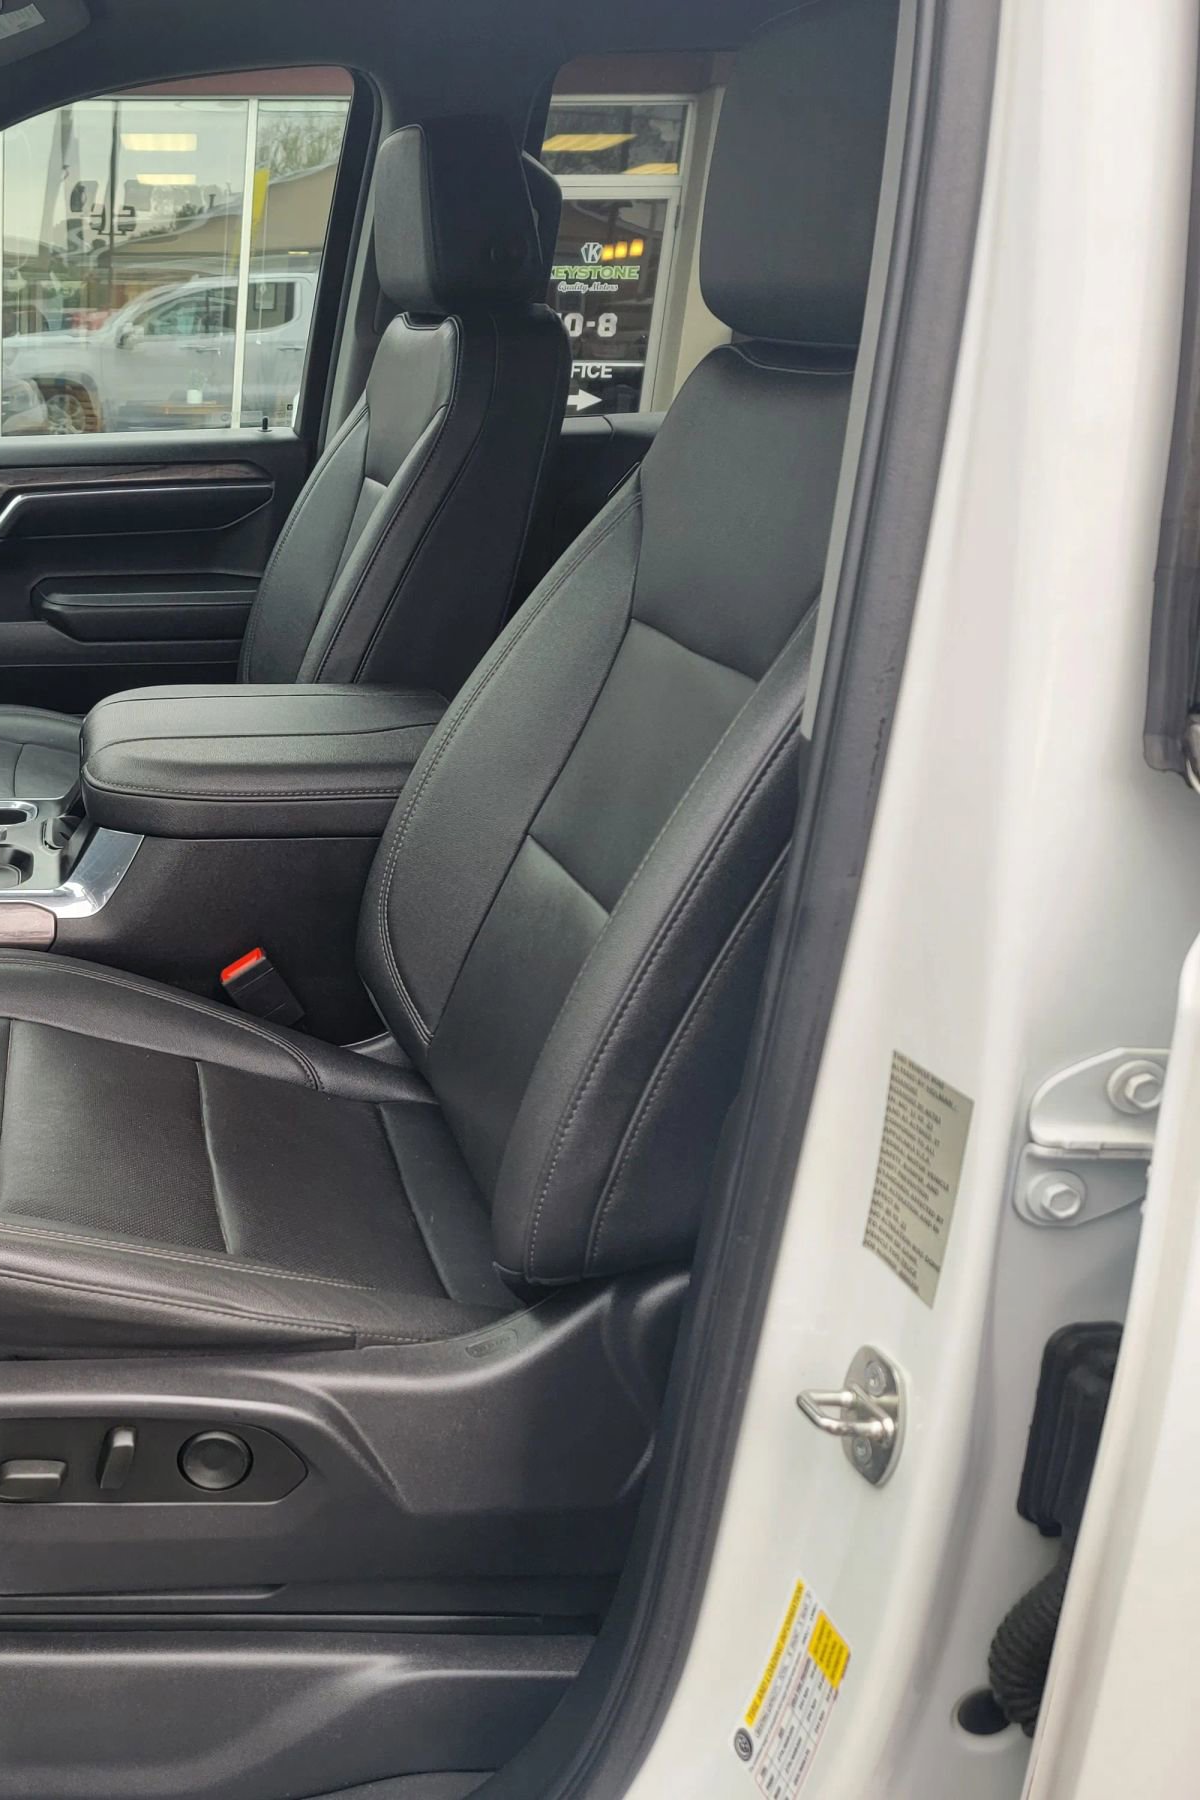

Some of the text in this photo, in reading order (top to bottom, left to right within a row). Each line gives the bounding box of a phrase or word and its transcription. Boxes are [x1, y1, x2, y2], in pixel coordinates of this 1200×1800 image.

[558, 281, 619, 294] Quality Motors
[557, 312, 618, 337] 0-8
